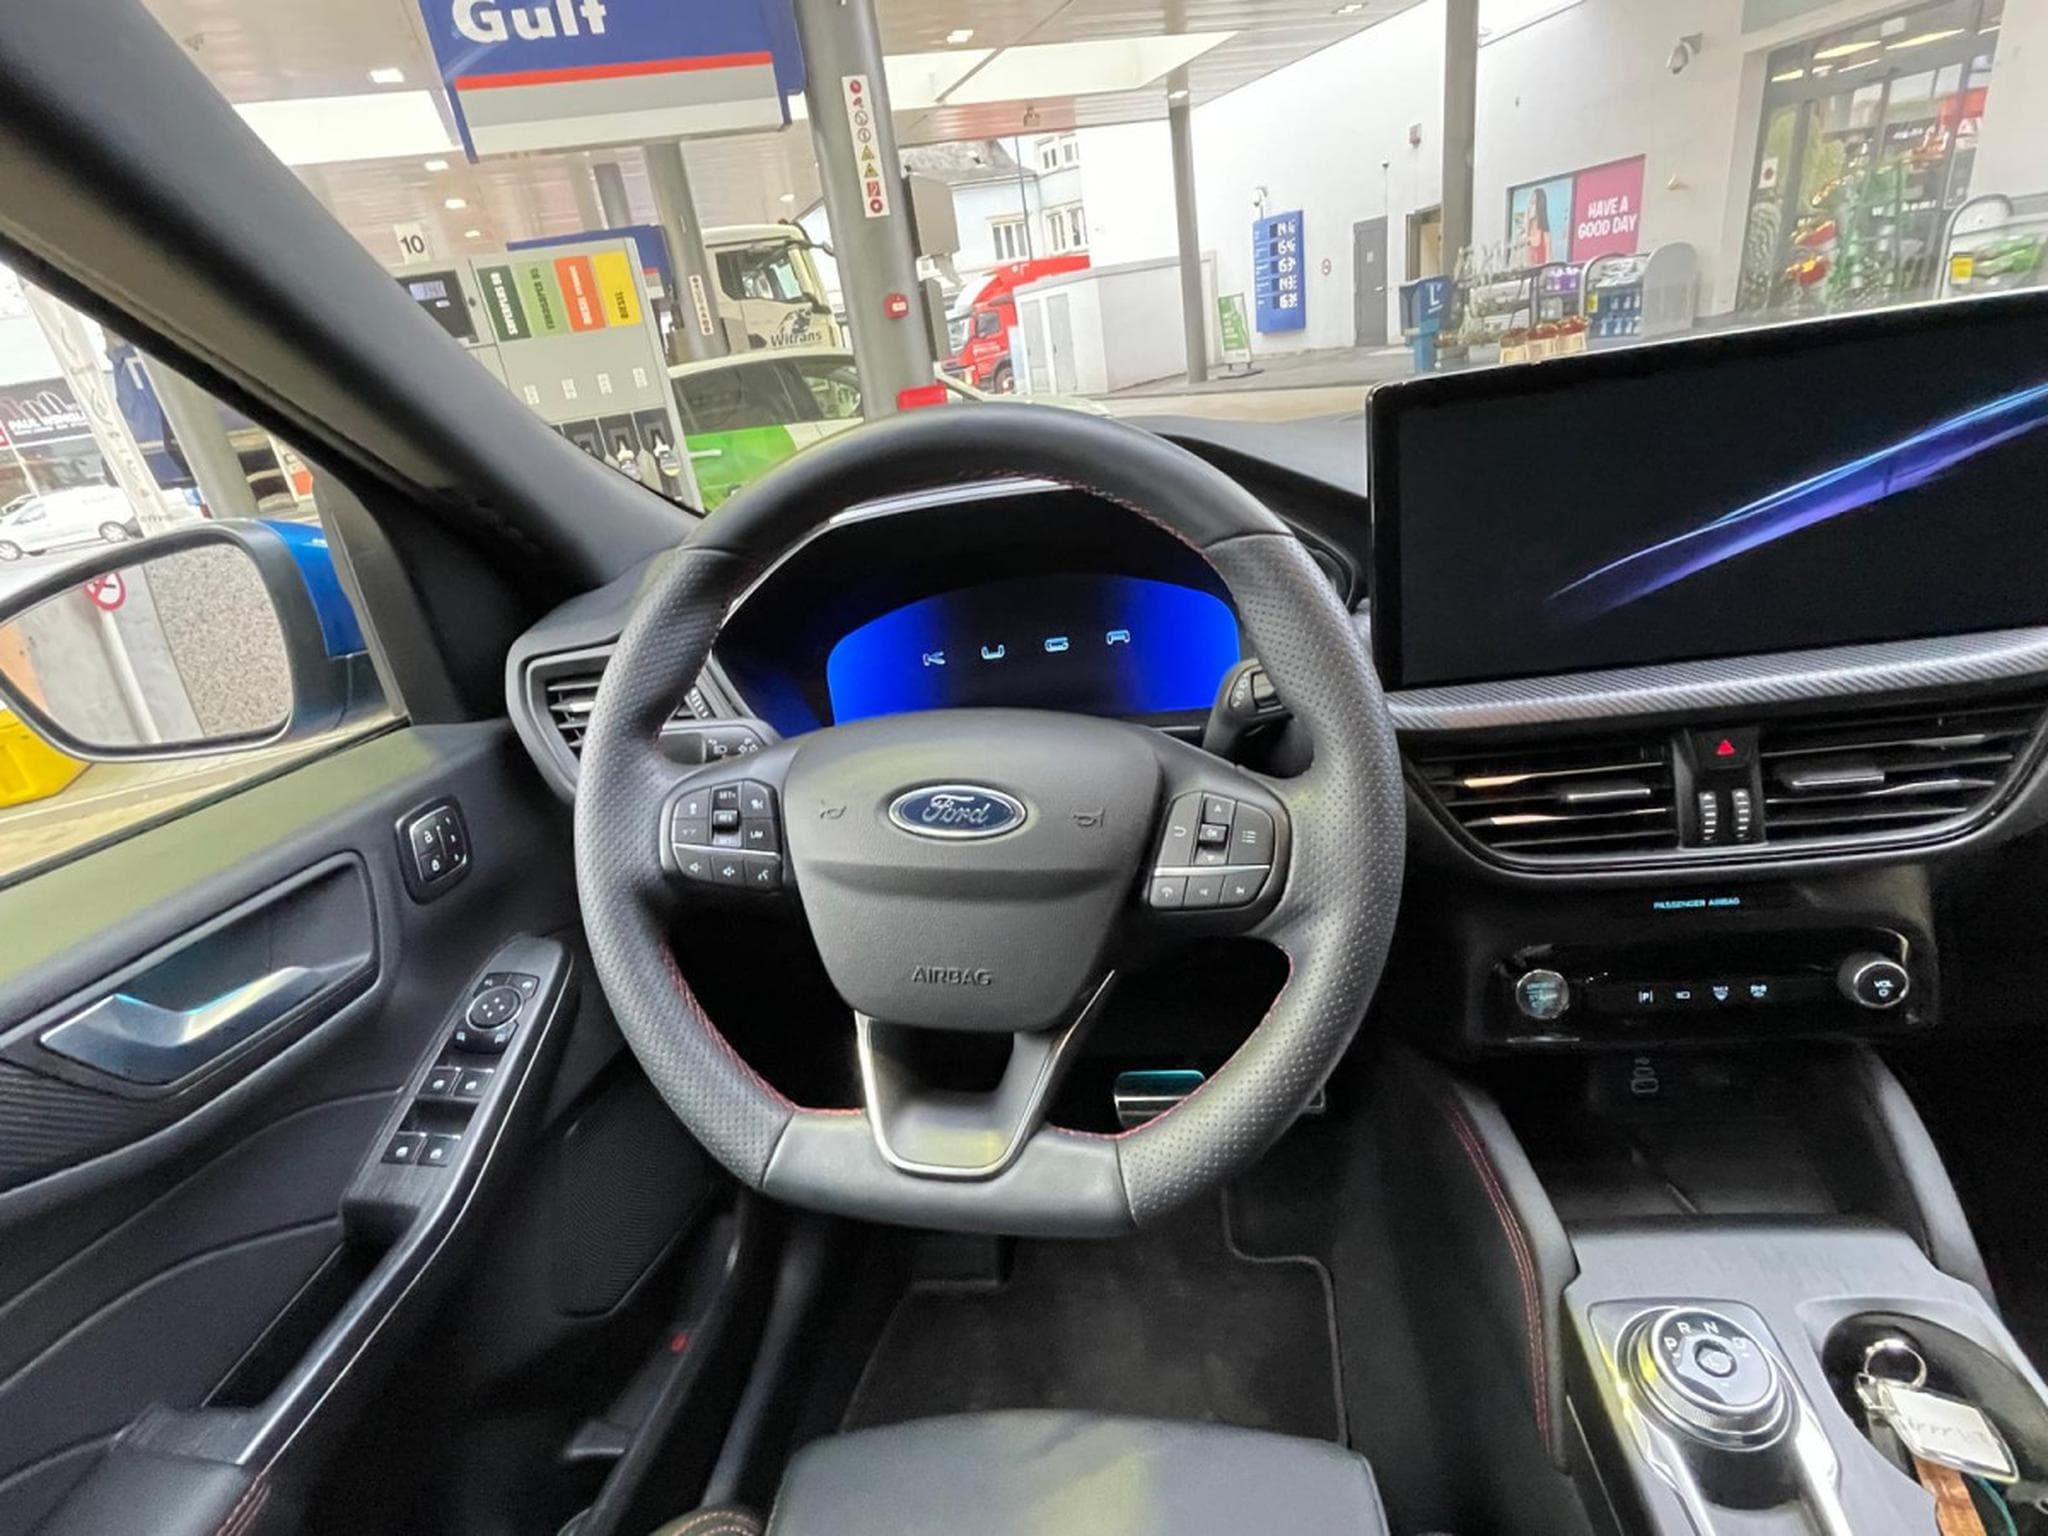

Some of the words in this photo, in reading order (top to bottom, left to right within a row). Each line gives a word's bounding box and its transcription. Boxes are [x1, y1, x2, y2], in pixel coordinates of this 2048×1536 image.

[452, 0, 607, 43] Gulf
[1588, 197, 1618, 219] HAVE
[1620, 195, 1628, 213] A
[1578, 219, 1611, 240] GOOD
[1612, 214, 1637, 234] DAY
[401, 235, 425, 254] 10
[771, 327, 822, 347] Witrans
[922, 793, 991, 824] Ford
[1653, 899, 1706, 909] PASSENGER
[911, 964, 993, 986] AIRBAG
[1676, 1321, 1692, 1334] R
[1702, 1321, 1719, 1335] N
